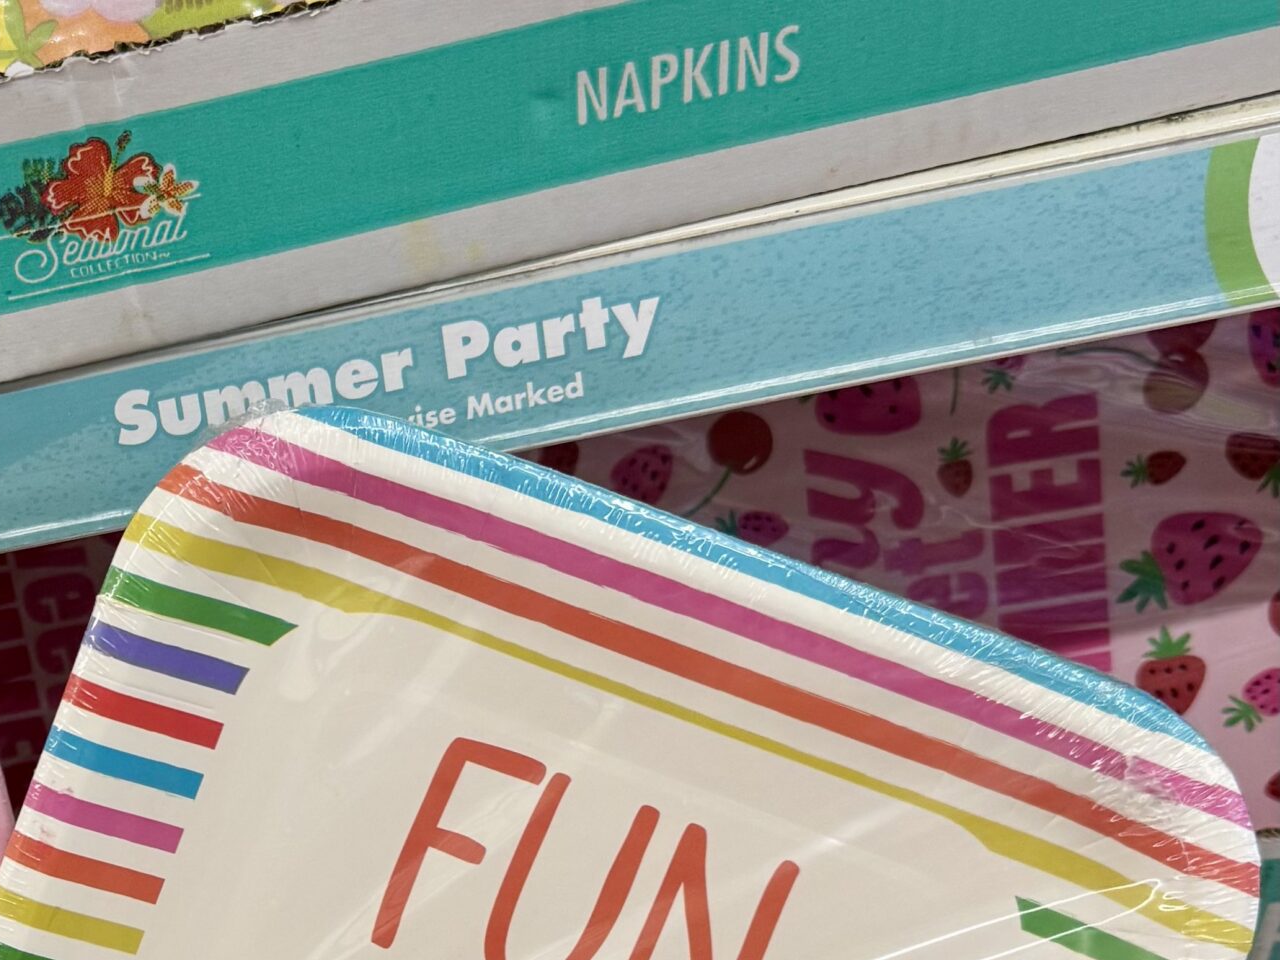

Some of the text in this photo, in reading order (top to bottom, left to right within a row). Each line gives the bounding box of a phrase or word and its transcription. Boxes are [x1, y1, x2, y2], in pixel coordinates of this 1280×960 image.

[577, 24, 801, 126] NAPKINS
[15, 201, 188, 283] Seasonal
[114, 296, 660, 446] Summer Party
[466, 371, 584, 420] Marked
